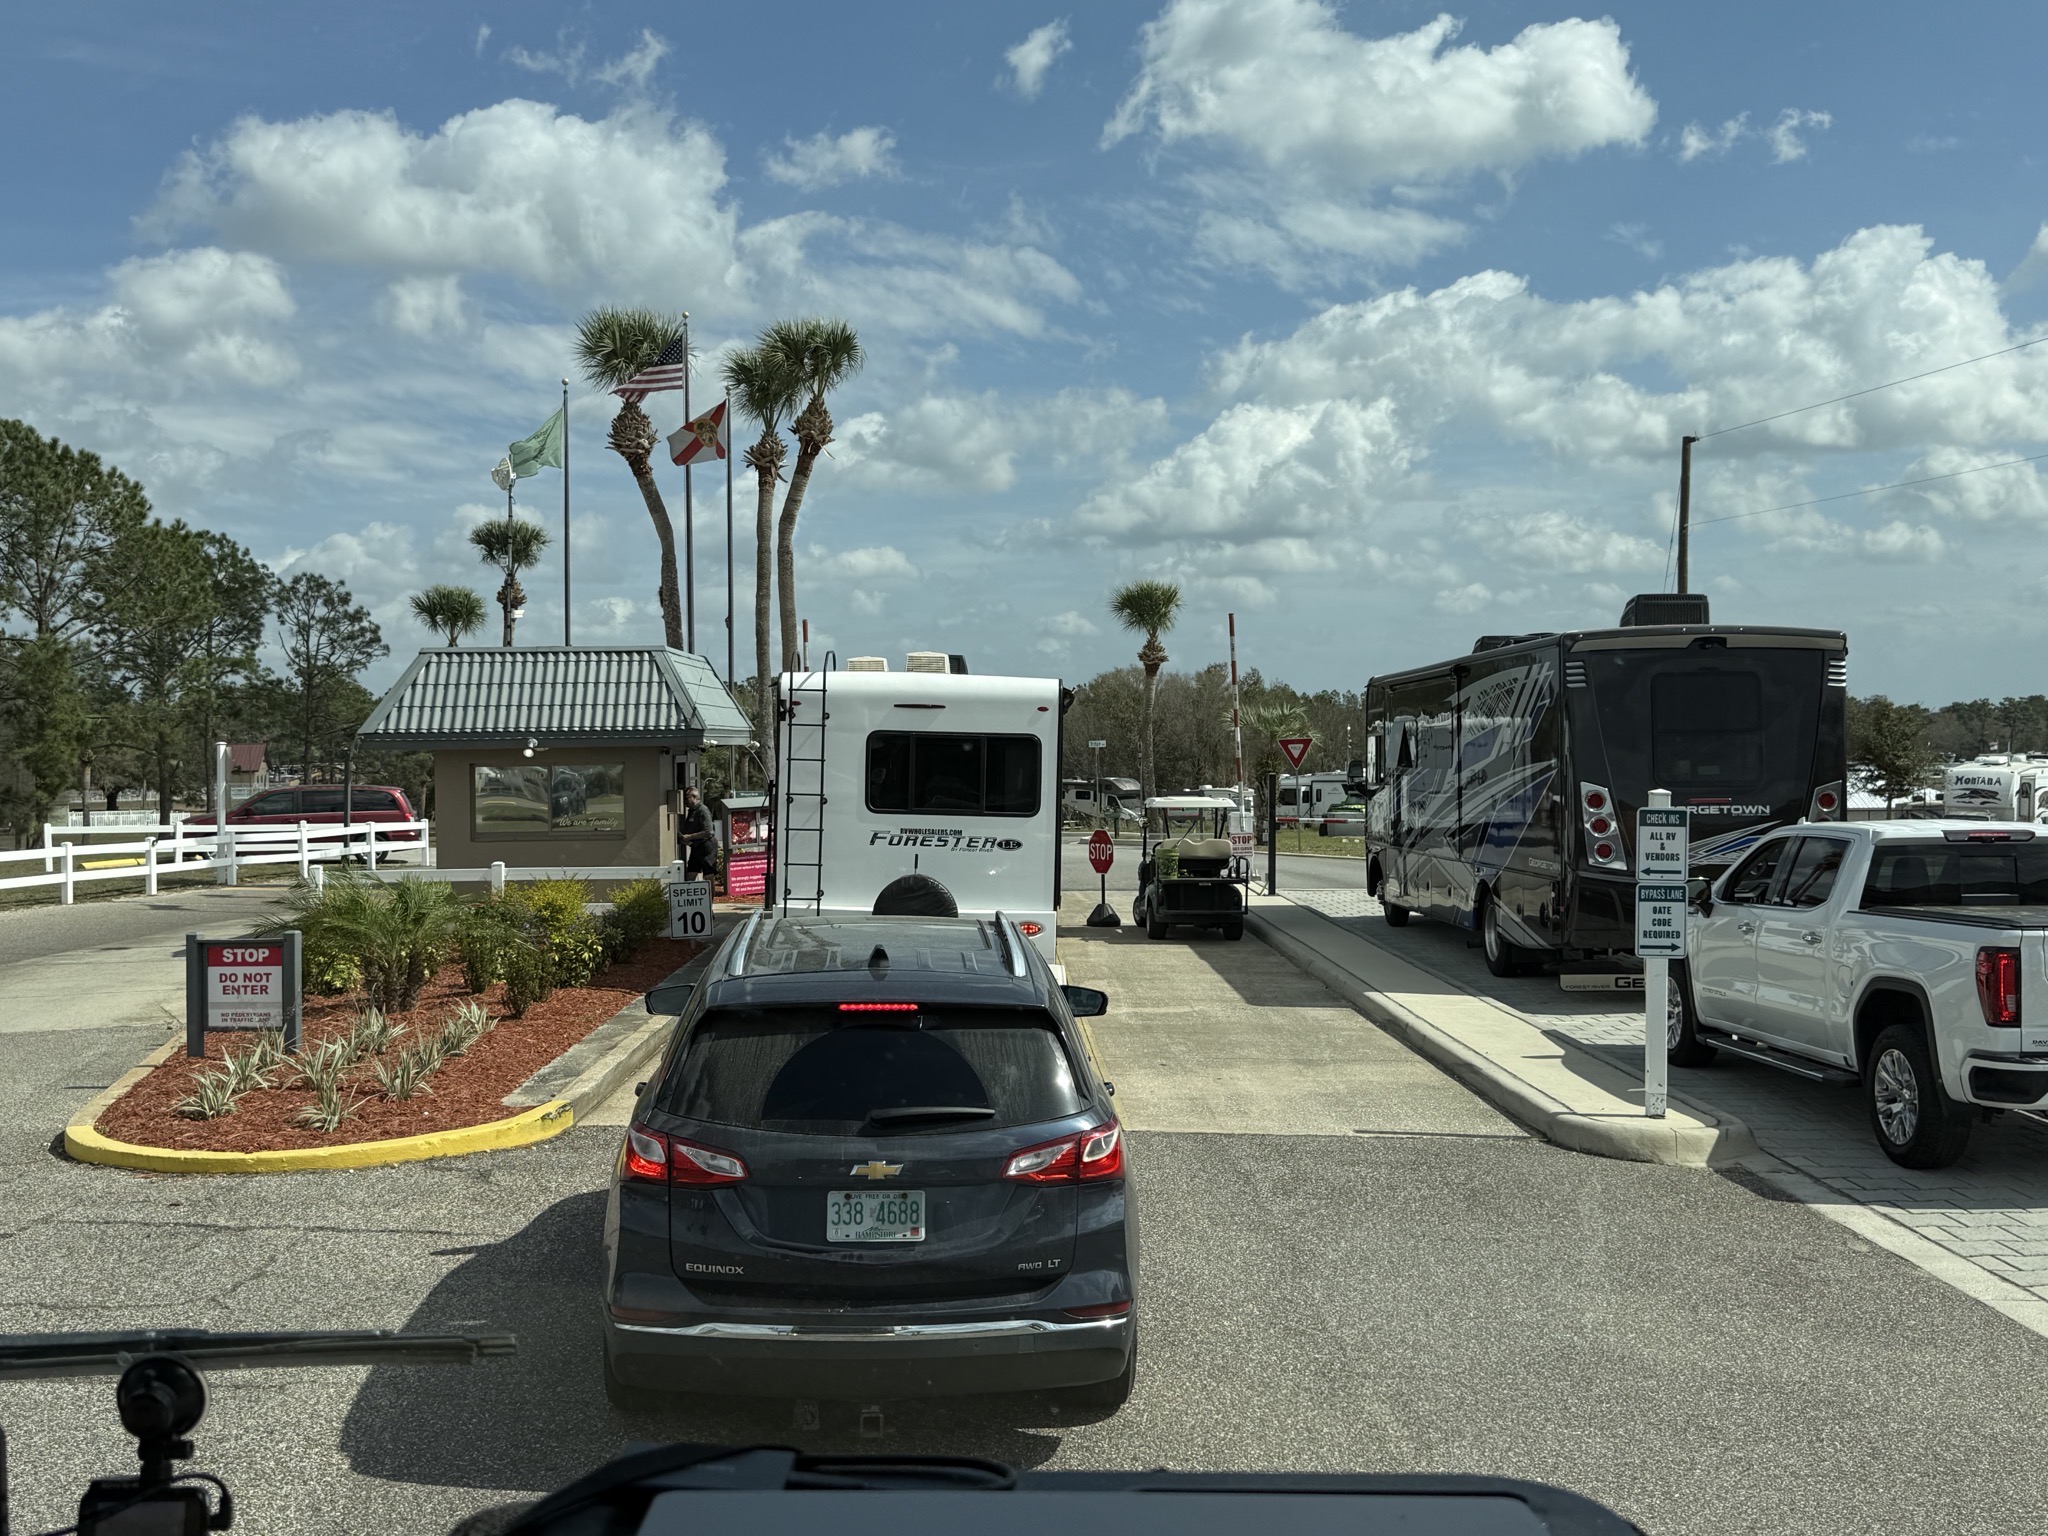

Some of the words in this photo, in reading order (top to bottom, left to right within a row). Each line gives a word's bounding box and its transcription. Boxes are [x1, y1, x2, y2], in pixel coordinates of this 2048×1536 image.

[556, 817, 571, 826] We
[588, 817, 618, 827] Family
[1646, 812, 1667, 824] CHECK
[1669, 814, 1680, 824] INS
[869, 830, 997, 848] FORESTER
[1232, 835, 1252, 845] STOP
[1650, 832, 1664, 840] ALL
[1665, 832, 1676, 840] RV
[1660, 842, 1665, 850] &
[1090, 843, 1112, 860] STOP
[1645, 853, 1680, 861] VENDORS
[673, 887, 707, 897] SPEED
[1641, 889, 1665, 900] BYPASS
[1667, 890, 1683, 900] LANE
[678, 898, 704, 907] LIMIT
[678, 911, 705, 934] 10
[1652, 918, 1672, 927] CODE
[1643, 930, 1681, 939] REQUIRED
[222, 948, 270, 963] STOP
[219, 973, 239, 983] DO
[243, 973, 272, 983] NOT
[222, 985, 269, 995] ENTER
[831, 1201, 863, 1226] 338
[876, 1201, 920, 1225] 4688
[686, 1263, 744, 1274] EQUINOX
[1018, 1261, 1042, 1270] AWD
[1048, 1259, 1061, 1268] LT
